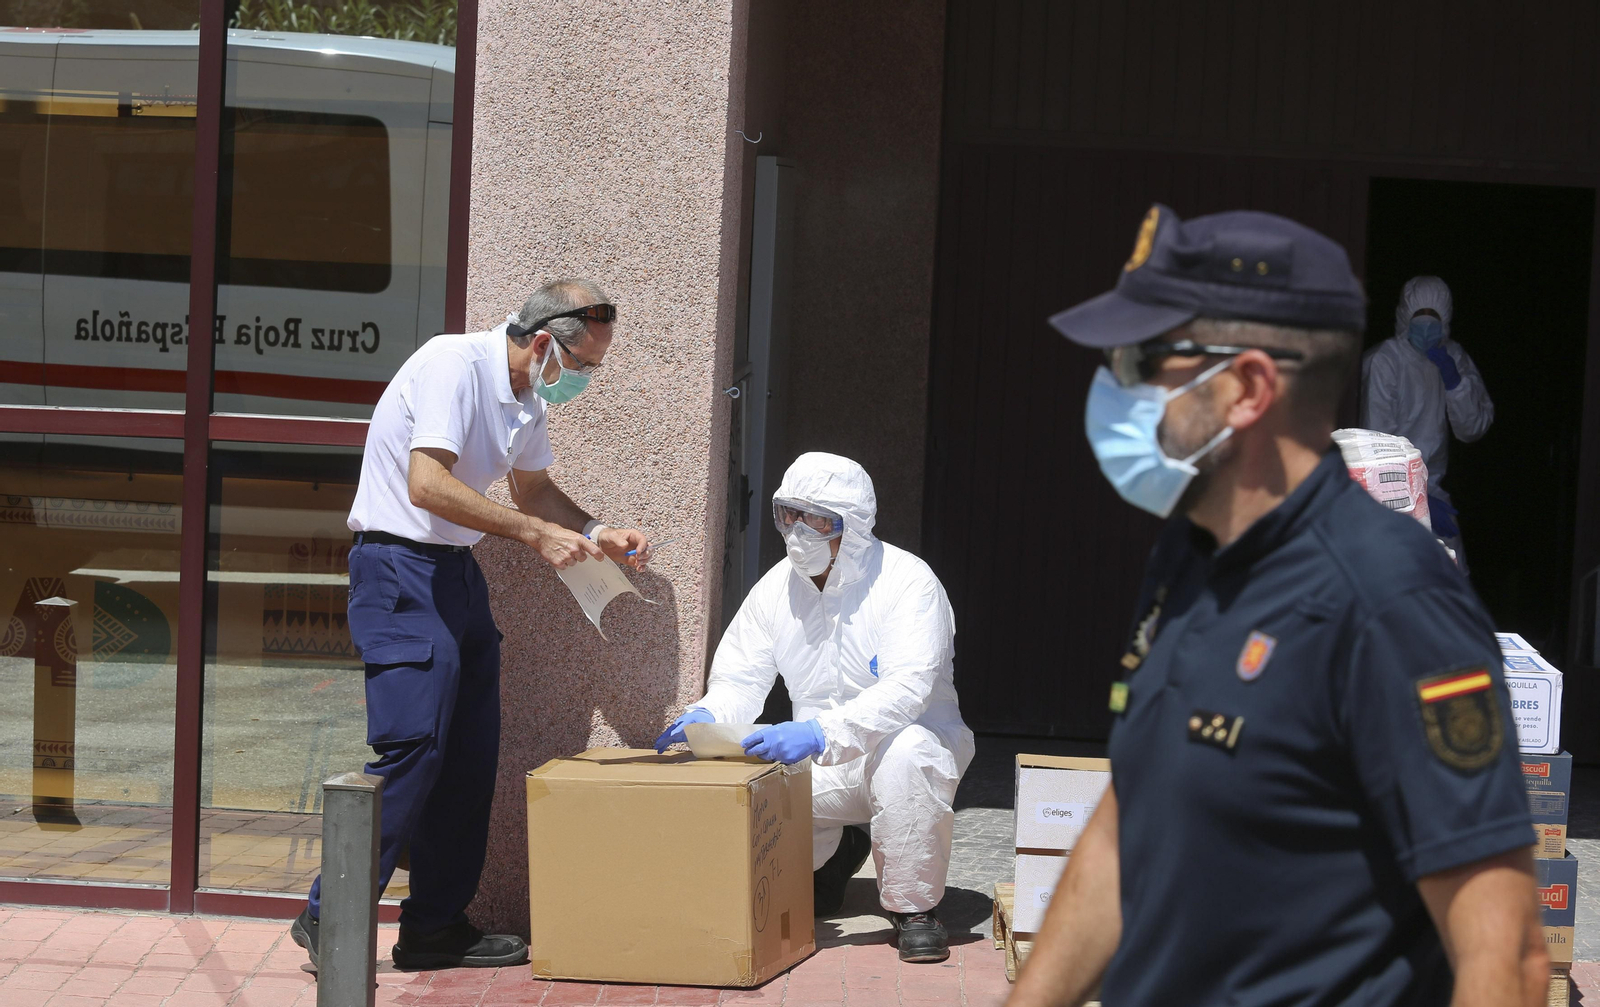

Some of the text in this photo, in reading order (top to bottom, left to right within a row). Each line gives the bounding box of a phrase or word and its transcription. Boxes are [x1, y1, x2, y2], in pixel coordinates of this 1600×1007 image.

[1506, 681, 1538, 689] NQUILLA
[1511, 699, 1539, 710] BRES
[1521, 765, 1546, 773] ascual
